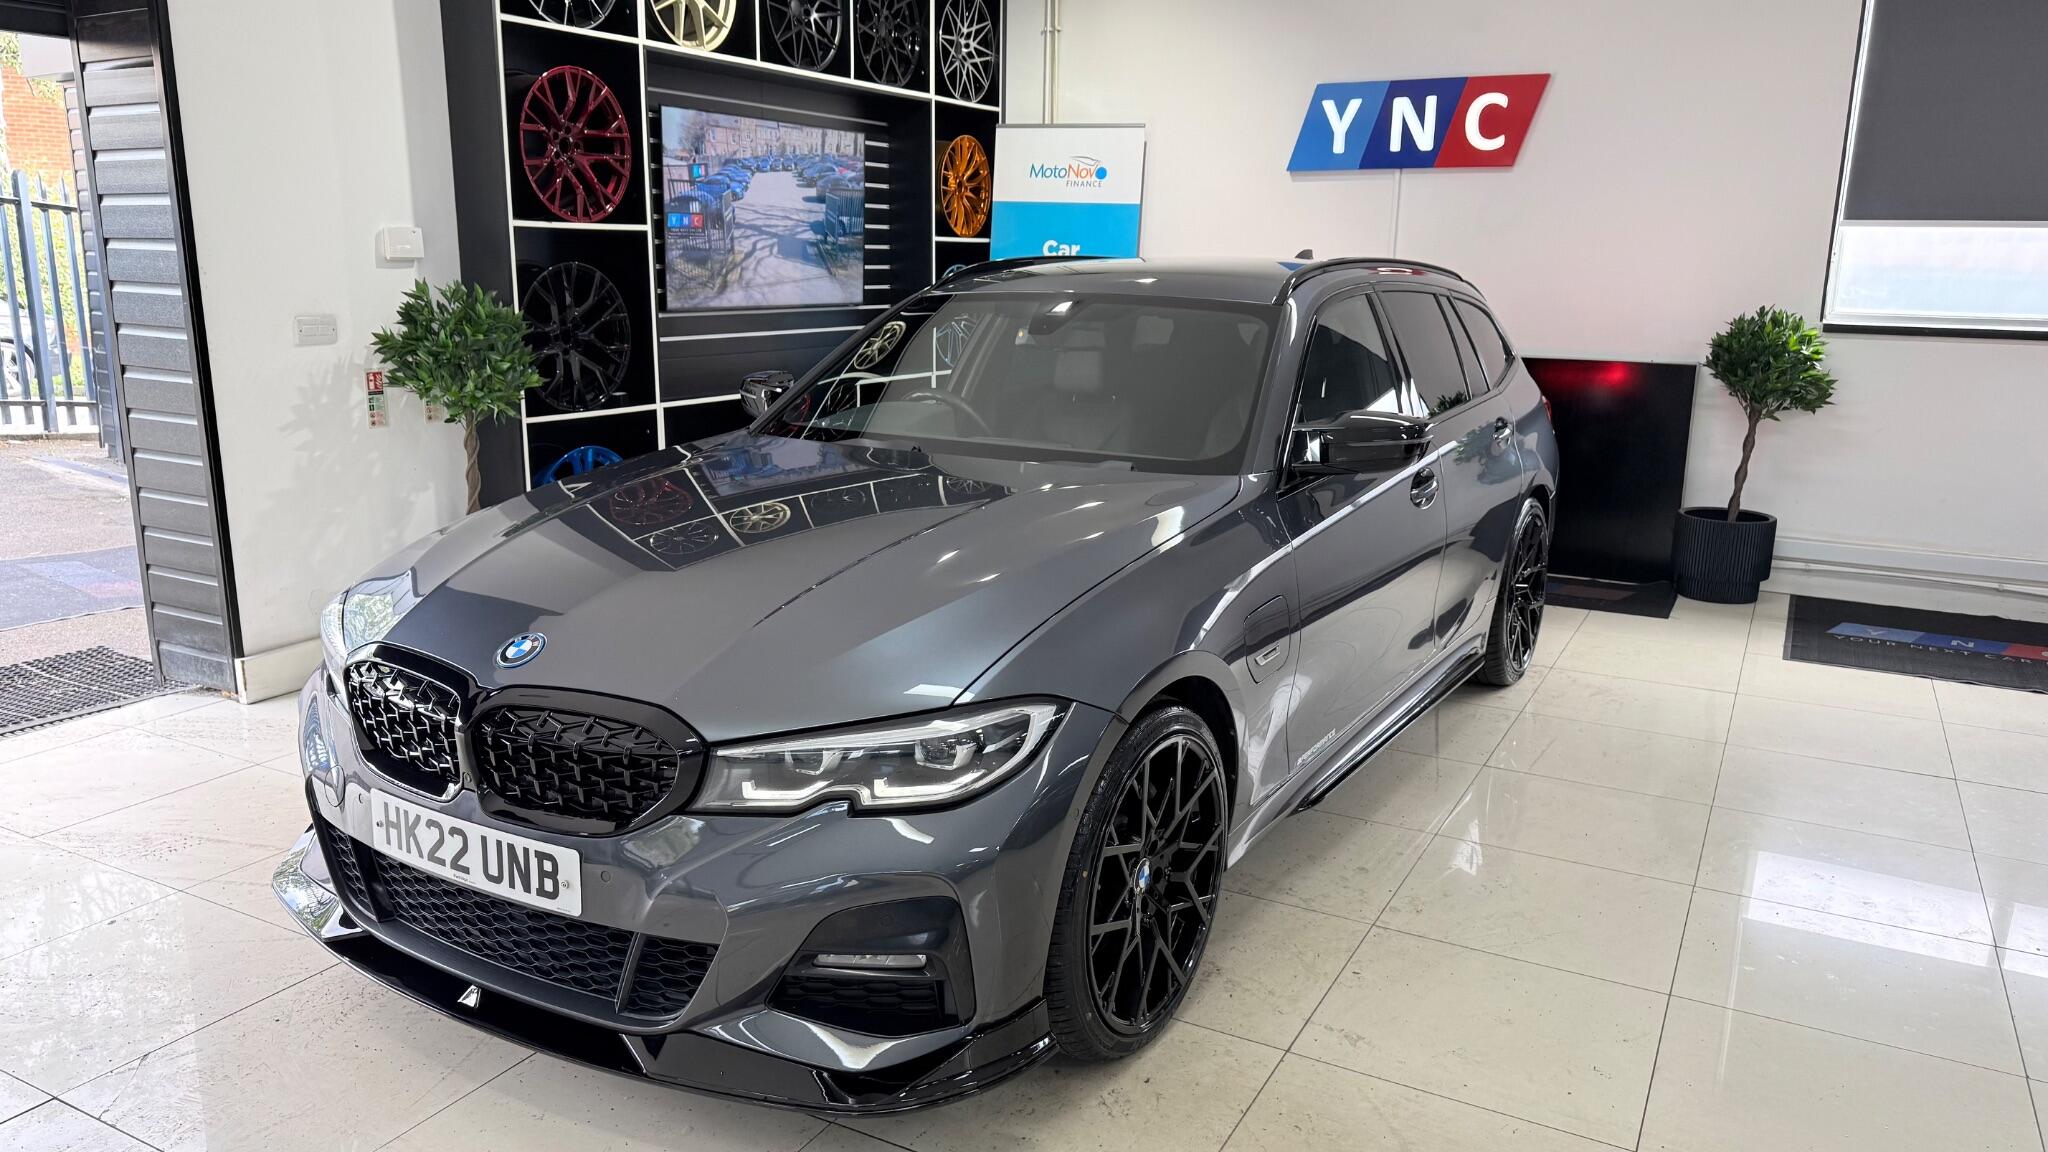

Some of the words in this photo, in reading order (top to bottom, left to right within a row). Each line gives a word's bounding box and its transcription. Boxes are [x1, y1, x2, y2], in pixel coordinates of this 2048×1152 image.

[1321, 92, 1509, 154] YNC
[1065, 180, 1103, 188] FINANCE
[1042, 240, 1081, 257] Car
[1833, 635, 1896, 646] YOUR
[1910, 643, 1972, 656] NEXT
[1984, 654, 2033, 664] CAR
[383, 801, 471, 876] HK22
[480, 834, 561, 901] UNB
